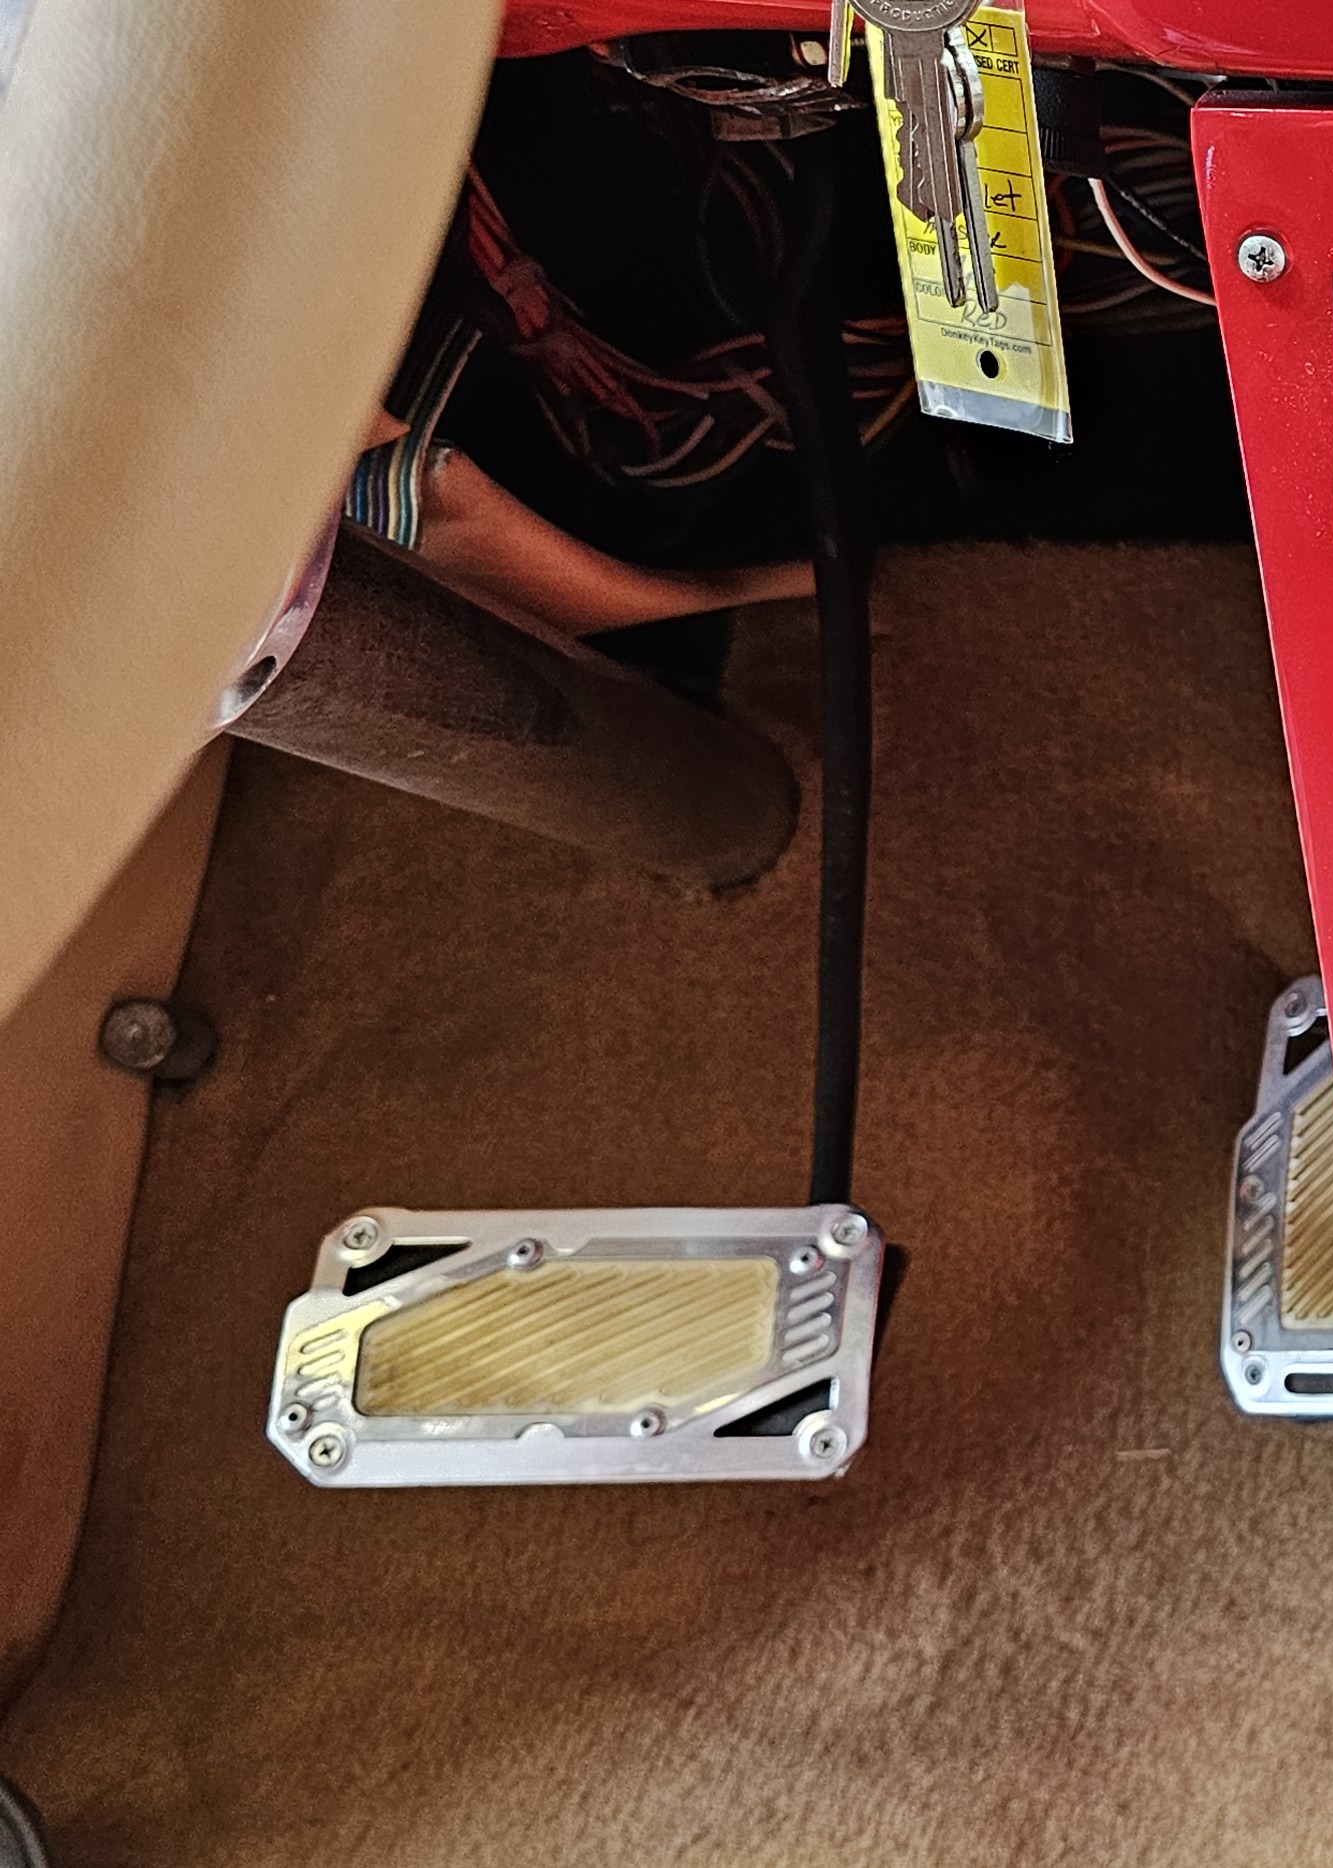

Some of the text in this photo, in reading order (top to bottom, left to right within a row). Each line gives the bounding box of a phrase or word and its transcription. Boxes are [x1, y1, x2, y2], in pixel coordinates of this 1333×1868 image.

[996, 60, 1020, 75] CERT
[909, 241, 937, 256] BODY
[940, 327, 1033, 354] DonkeyKeyTags.com
